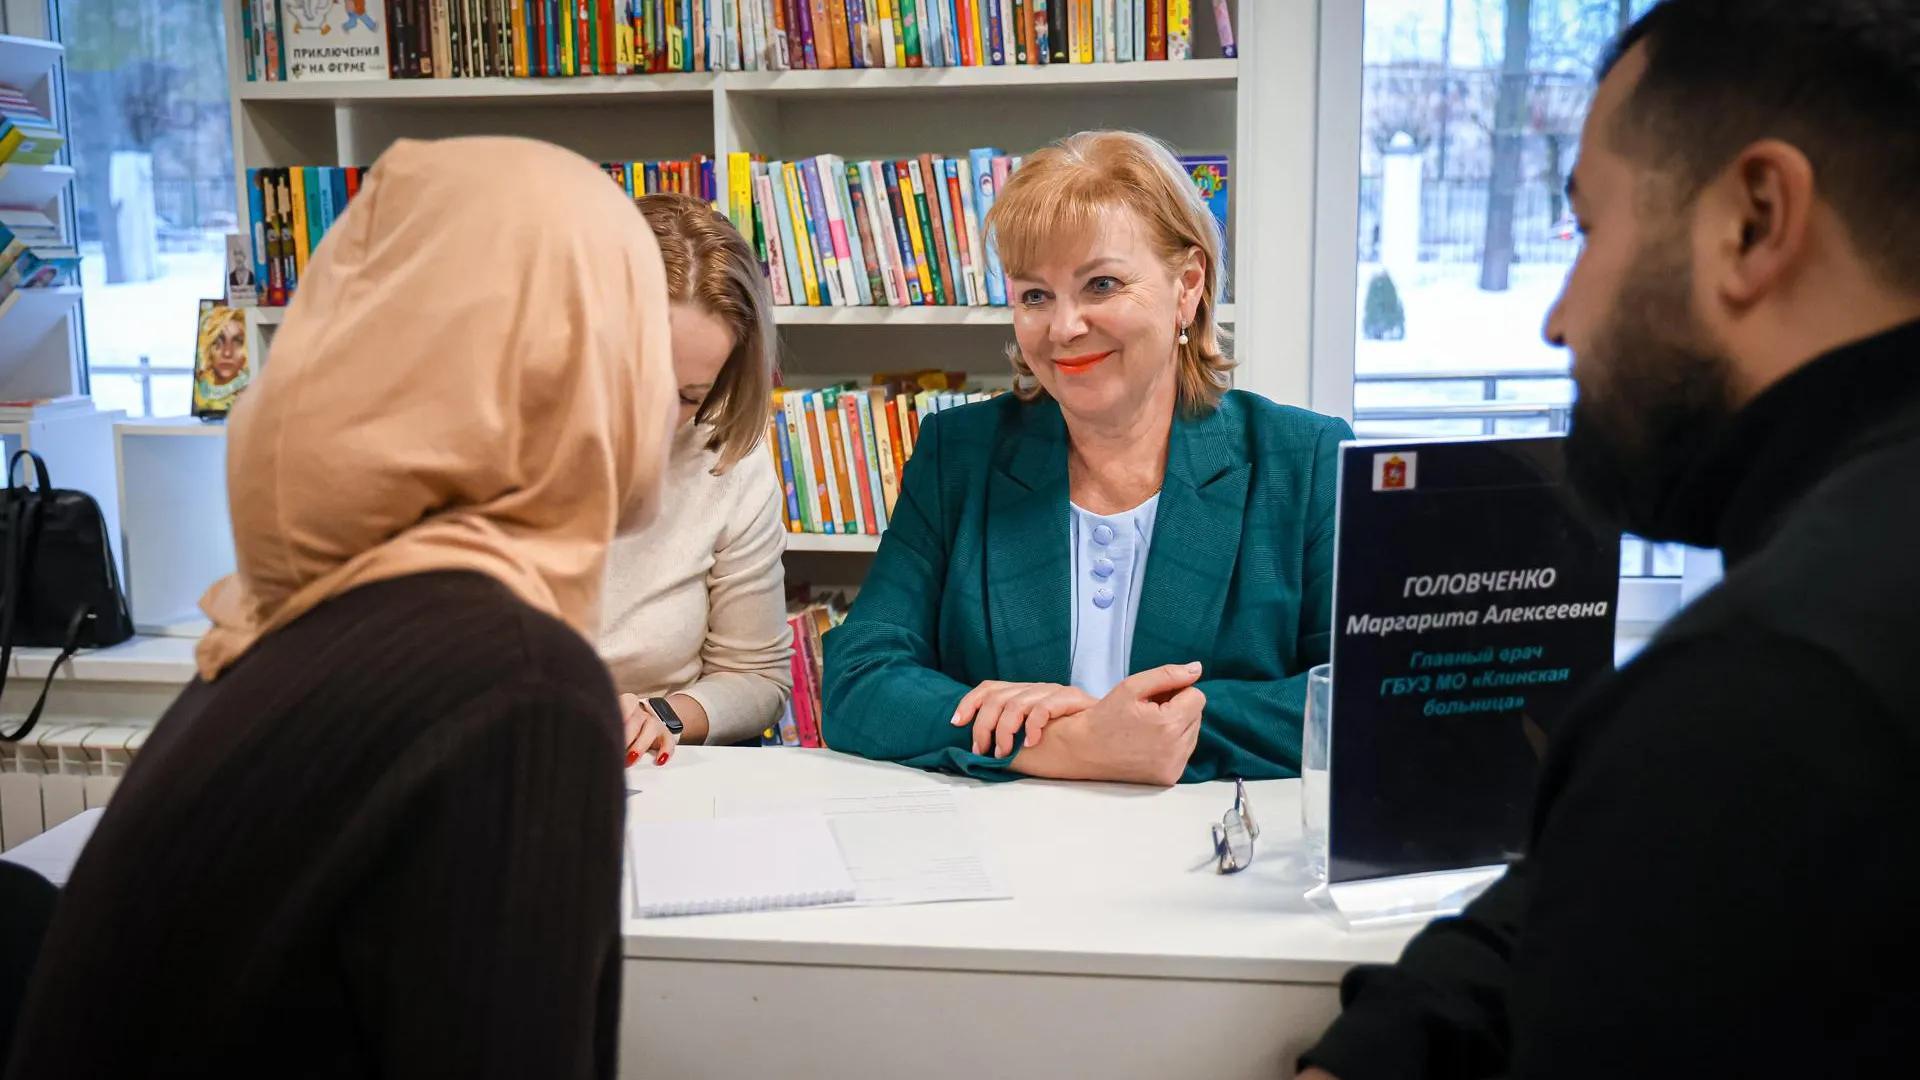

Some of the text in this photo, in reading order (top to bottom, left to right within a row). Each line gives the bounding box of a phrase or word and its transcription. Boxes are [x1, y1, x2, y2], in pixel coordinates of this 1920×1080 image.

[293, 46, 380, 59] ПРИКЛЮЧЕНИЯ
[309, 62, 366, 73] НА ФЕРМЕ
[1403, 567, 1556, 598] ГОЛОВЧЕНКО
[1346, 601, 1608, 636] Маргарита Алексеевна
[1410, 646, 1543, 668] Главный врач
[1380, 667, 1570, 696] ГБУЗ МО «Клинская
[1423, 696, 1525, 717] больница»
